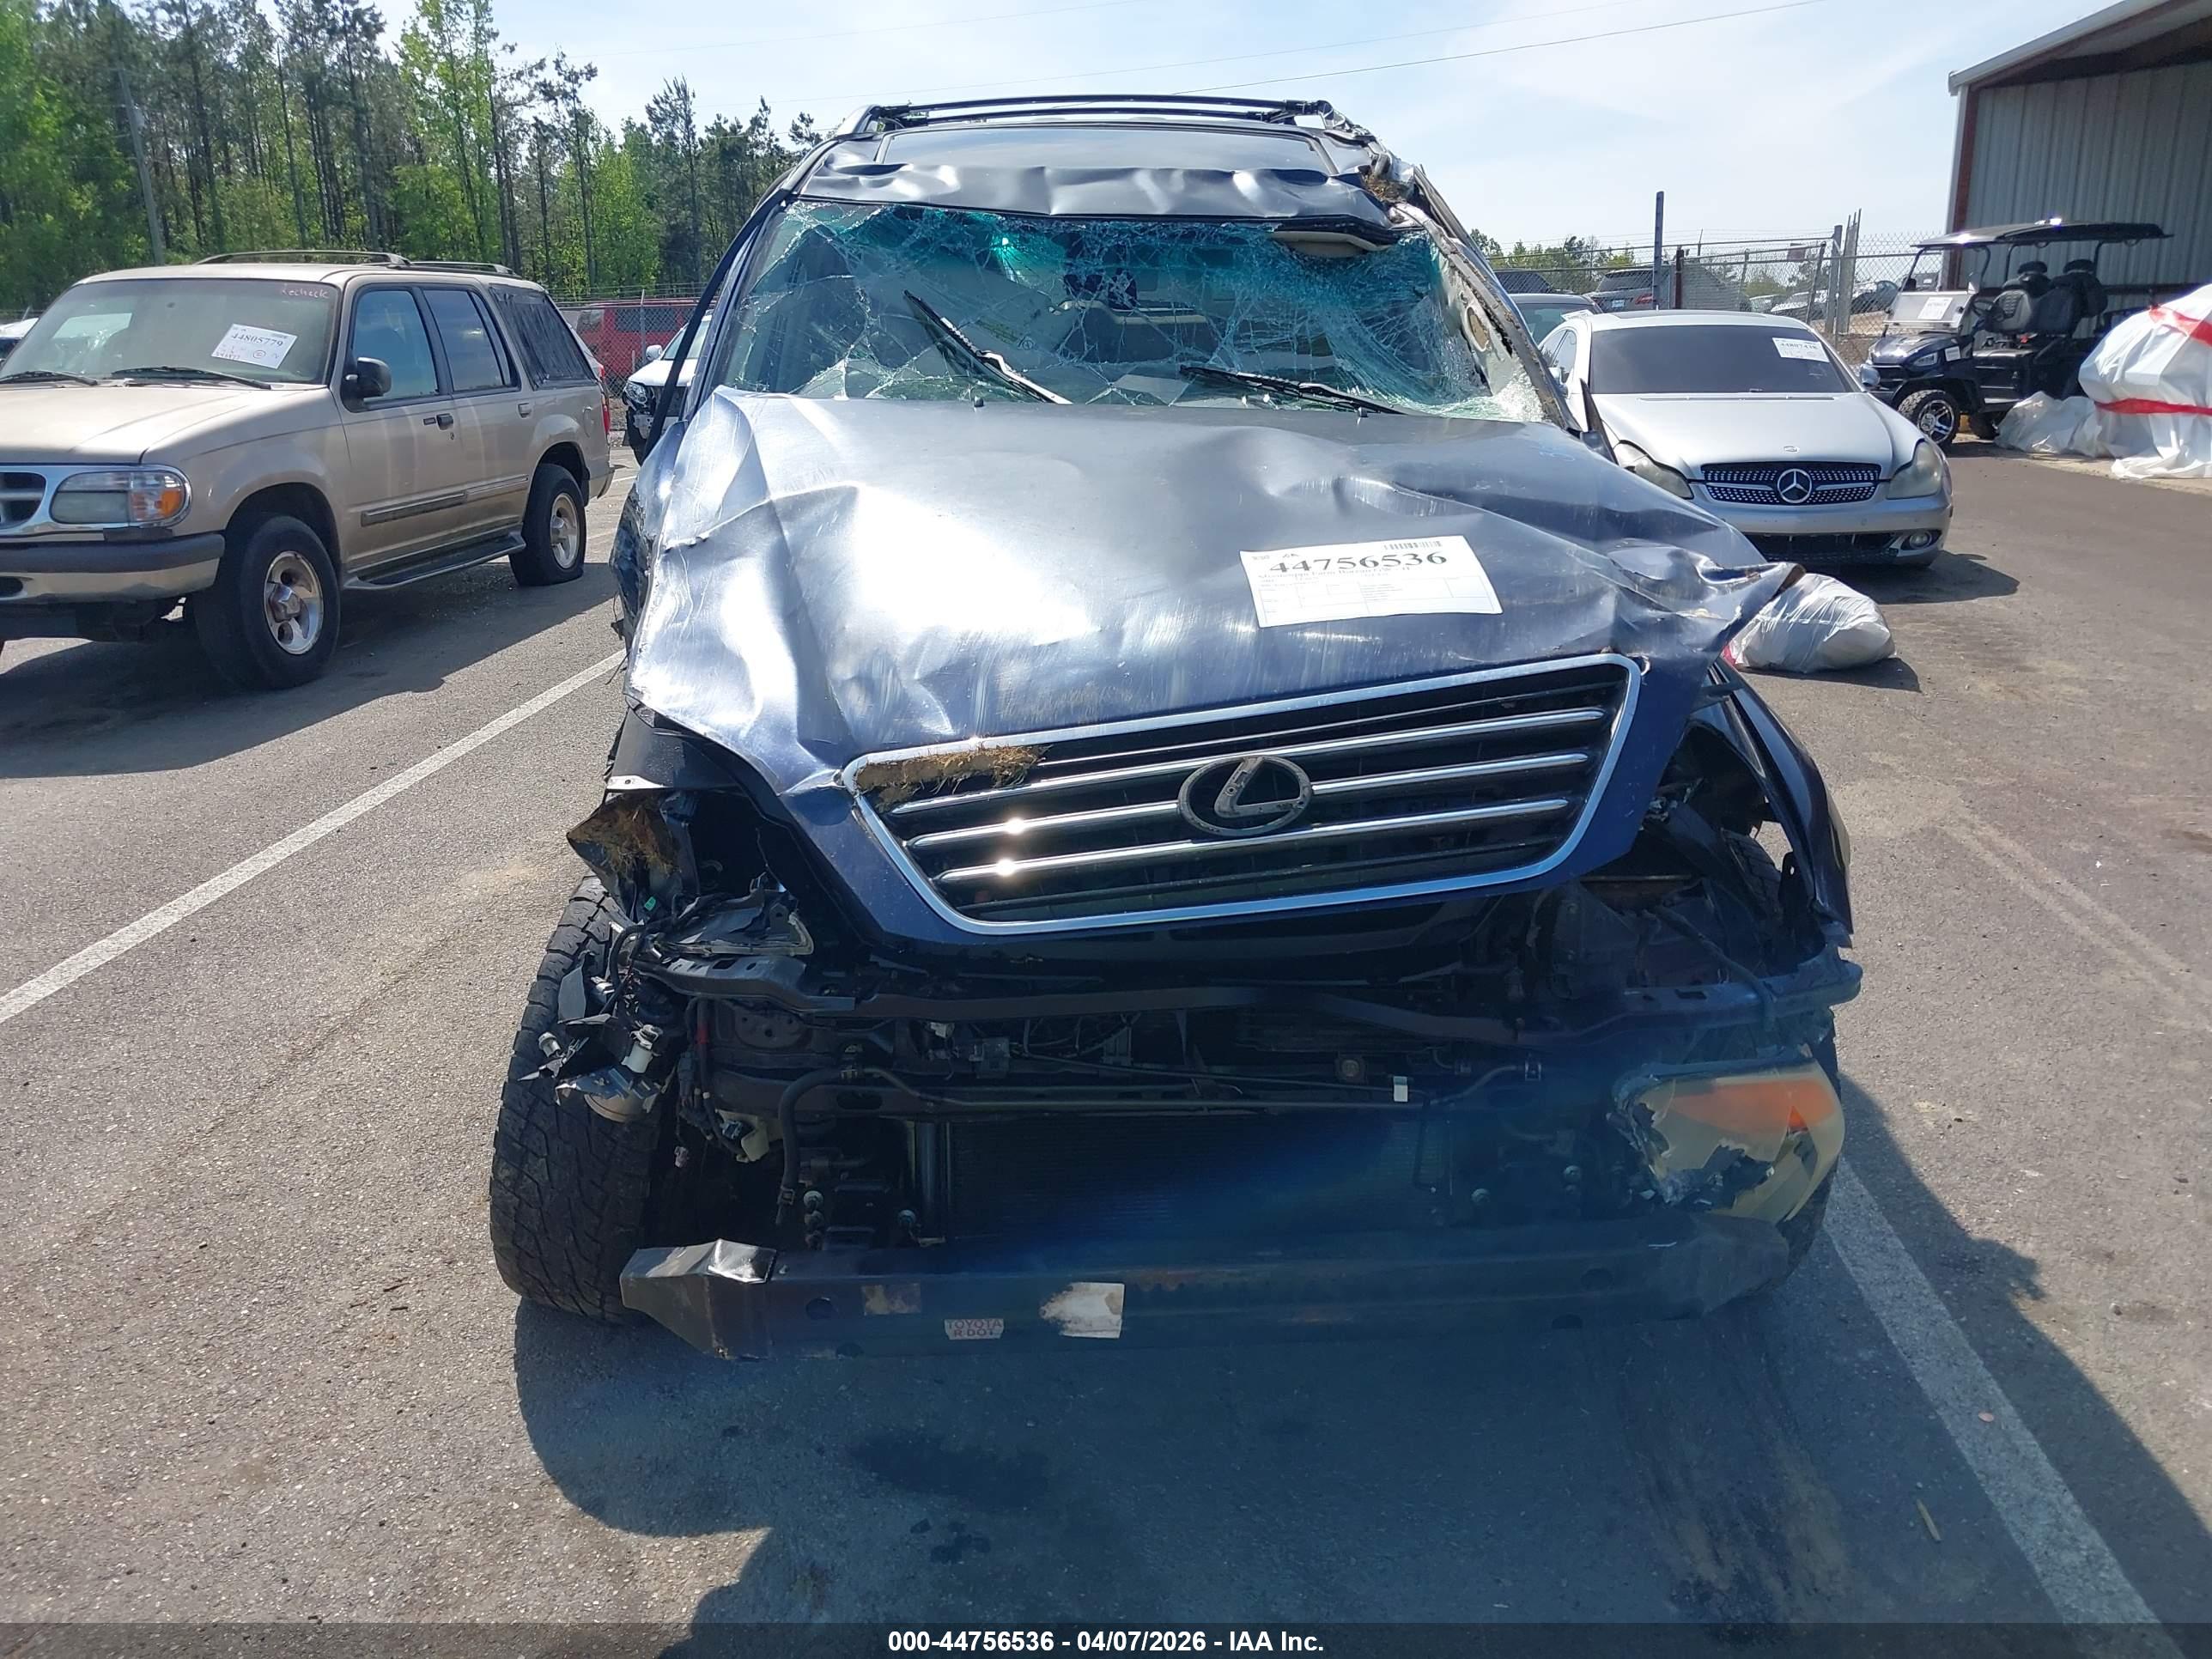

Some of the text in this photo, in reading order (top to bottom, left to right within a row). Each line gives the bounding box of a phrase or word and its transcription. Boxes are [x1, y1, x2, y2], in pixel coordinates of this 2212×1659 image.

[231, 332, 284, 347] 44805779
[1268, 551, 1448, 573] 44756536
[947, 1319, 1003, 1329] TOYOTA
